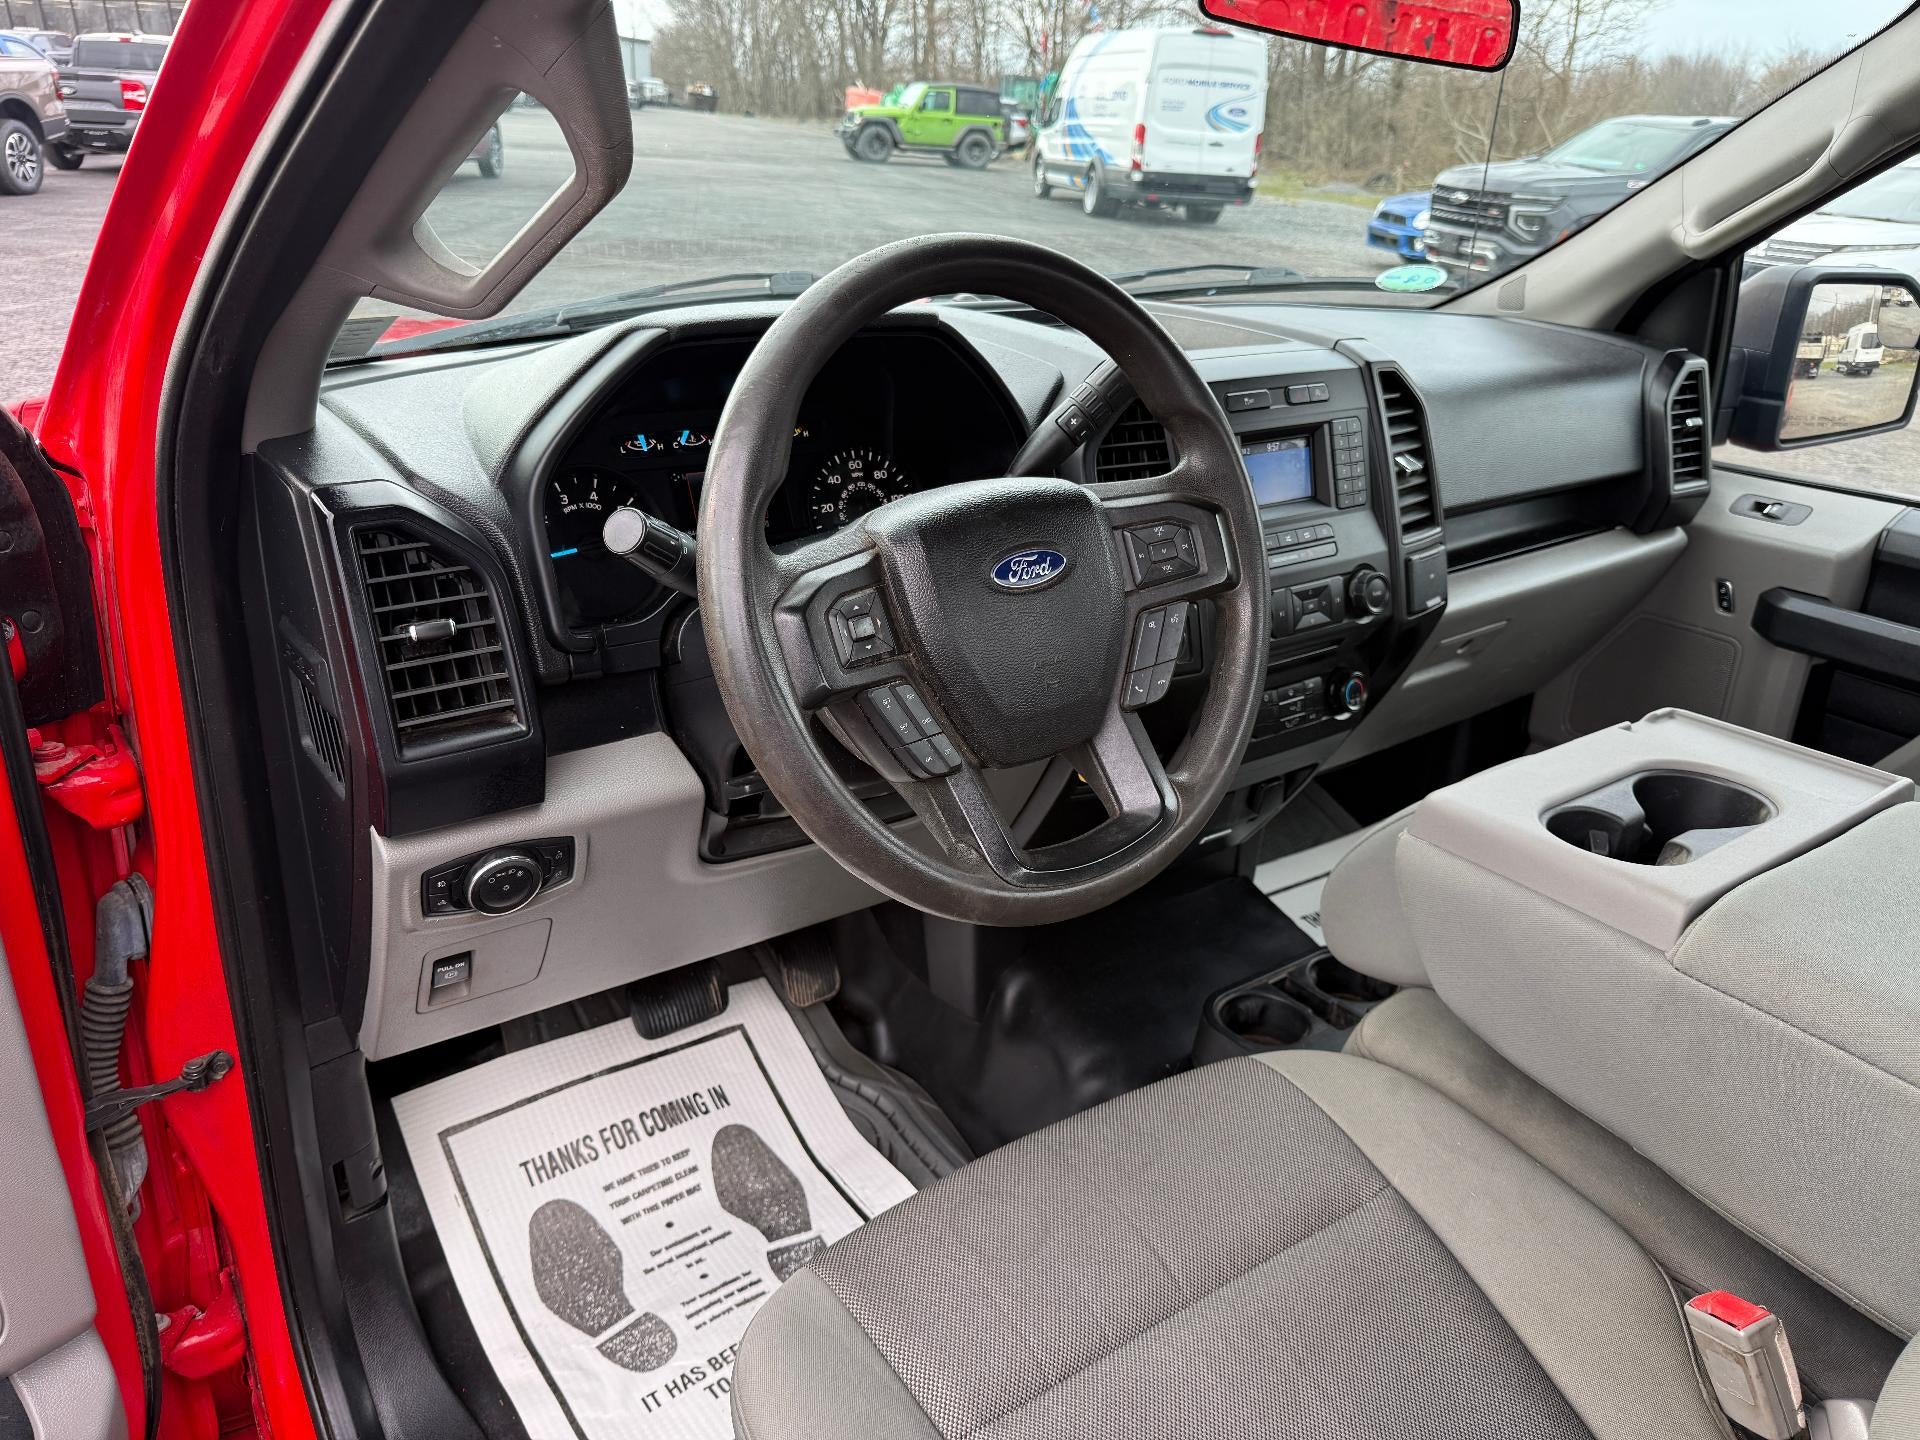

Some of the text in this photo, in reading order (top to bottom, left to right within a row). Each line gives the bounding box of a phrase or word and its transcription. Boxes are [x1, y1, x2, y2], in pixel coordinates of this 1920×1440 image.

[848, 460, 862, 469] 60
[827, 475, 841, 484] 40
[873, 470, 887, 480] 80
[560, 494, 569, 505] 3
[589, 491, 598, 501] 4
[563, 503, 578, 514] RPM
[820, 503, 834, 513] 20
[1009, 554, 1053, 583] Ford
[519, 1084, 731, 1187] THANKS FOR COMING IN
[661, 1156, 671, 1167] TO
[641, 1390, 662, 1413] IT
[664, 1366, 707, 1399] HAS
[703, 1377, 731, 1399] TO
